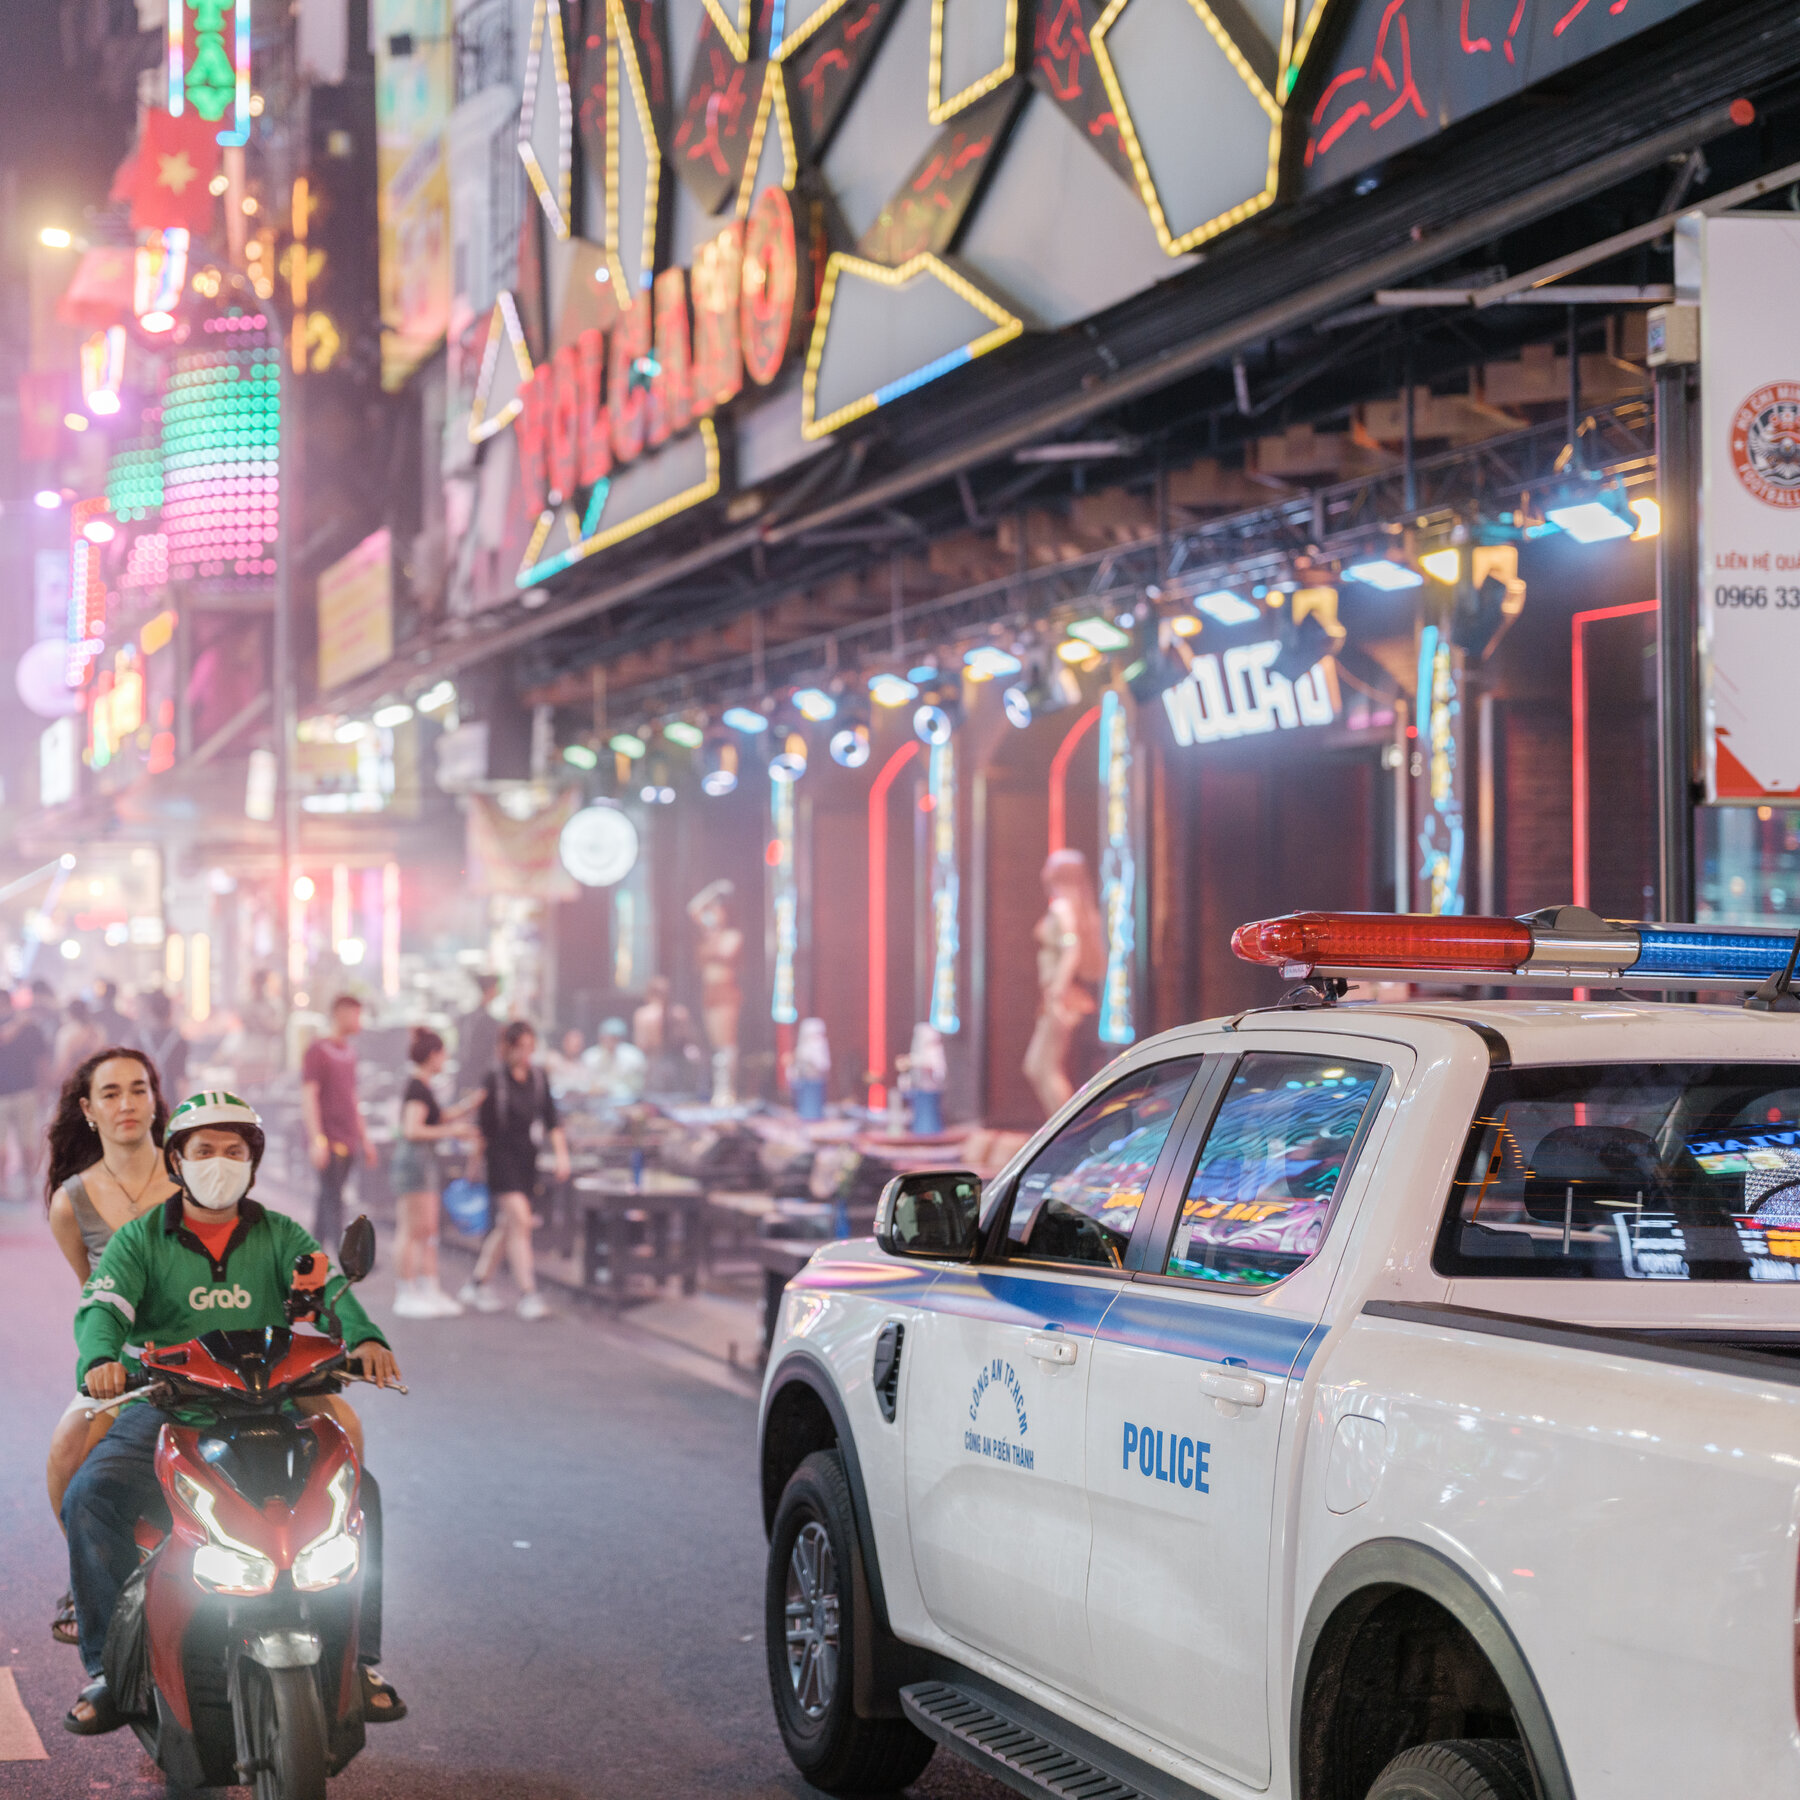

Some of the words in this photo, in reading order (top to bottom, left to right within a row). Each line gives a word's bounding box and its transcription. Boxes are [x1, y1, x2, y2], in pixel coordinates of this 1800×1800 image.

[1716, 549, 1748, 568] LIÊN
[1753, 551, 1770, 571] HỆ
[1715, 585, 1768, 609] 0966
[189, 1284, 251, 1311] Grab
[990, 1358, 1004, 1382] AN
[1004, 1362, 1028, 1436] TP.HCM
[964, 1427, 982, 1454] CÔNG
[982, 1436, 992, 1457] AN
[1123, 1421, 1211, 1494] POLICE
